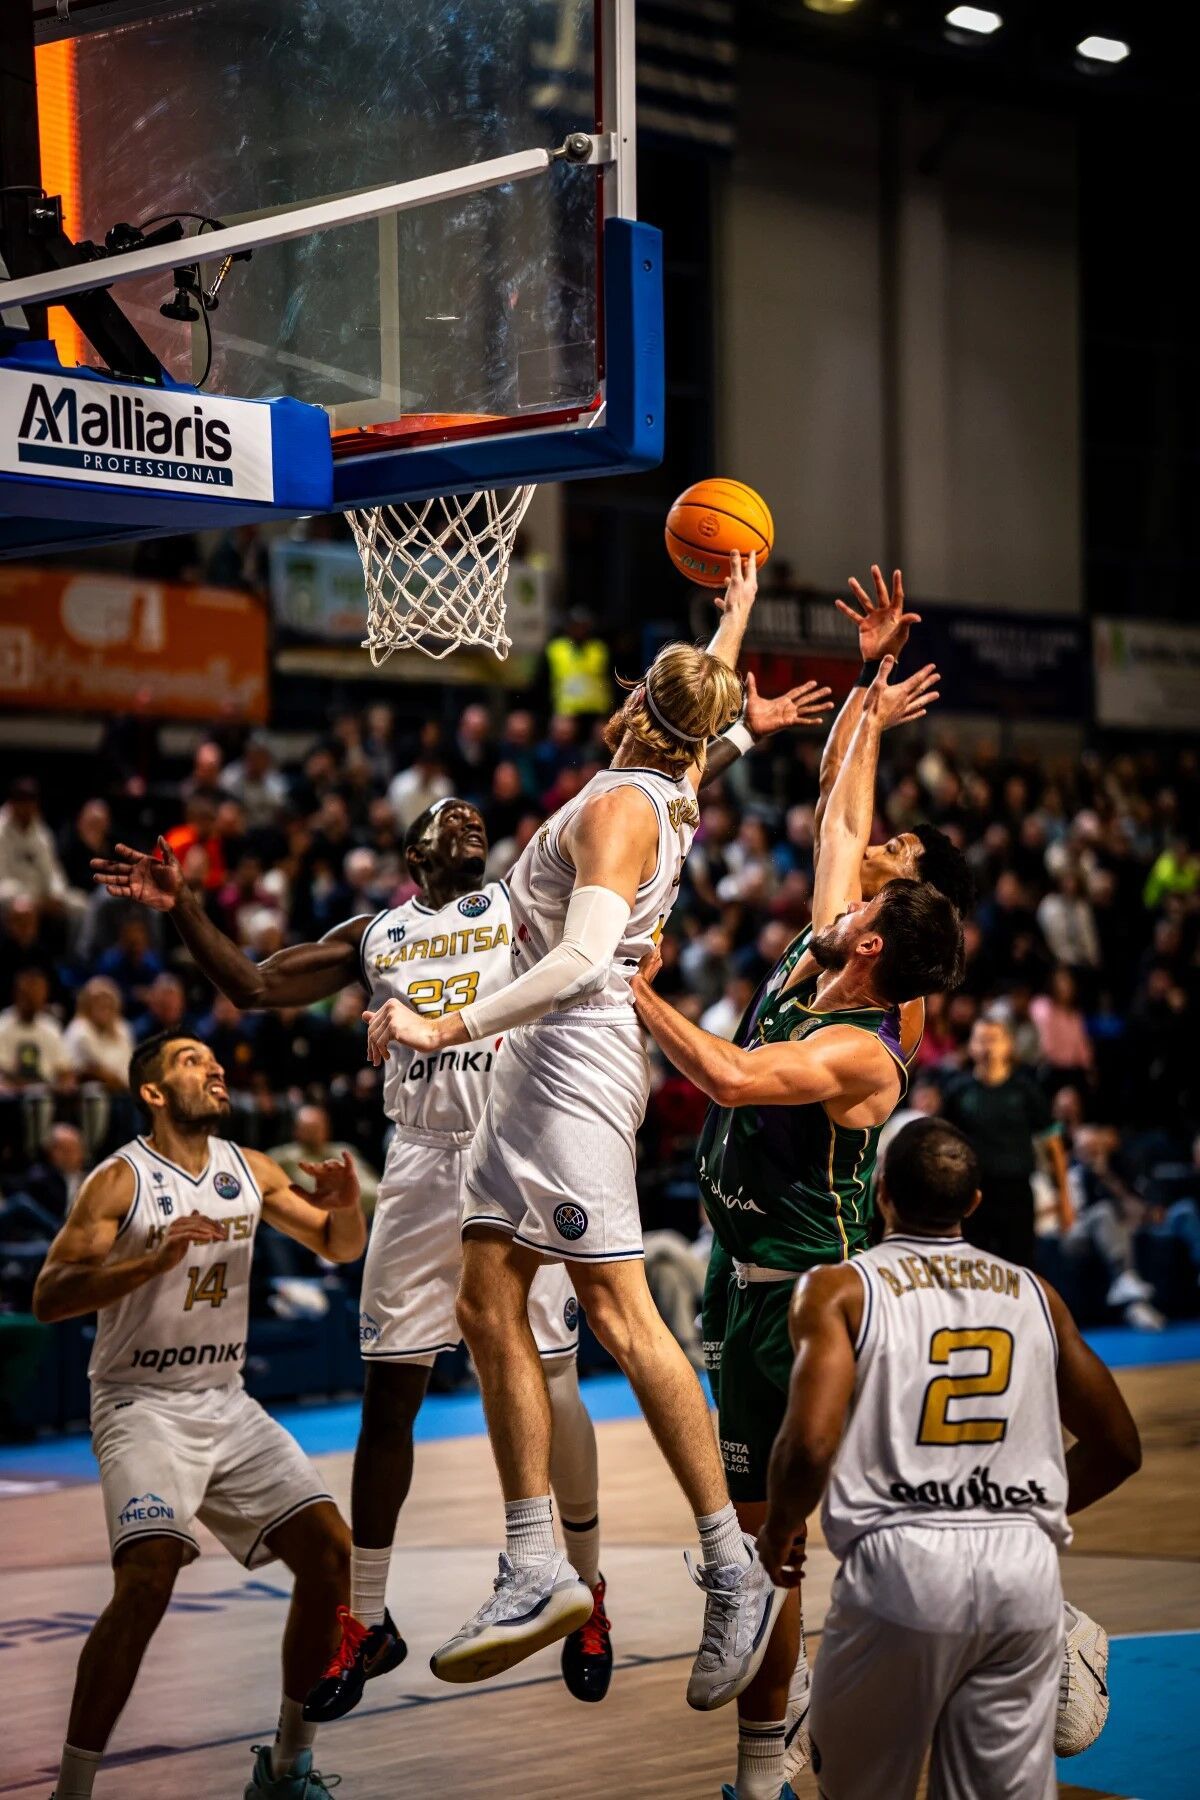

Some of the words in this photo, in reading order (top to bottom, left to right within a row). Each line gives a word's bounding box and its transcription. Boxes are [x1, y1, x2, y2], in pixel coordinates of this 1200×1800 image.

[18, 383, 232, 462] Malliaris
[83, 453, 227, 484] PROFESSIONAL
[374, 923, 510, 972] KARDITSA
[407, 971, 480, 1020] 23
[184, 1262, 227, 1311] 14
[916, 1326, 1014, 1446] 2
[720, 1440, 749, 1454] COSTA
[731, 1454, 750, 1464] SOL
[726, 1463, 750, 1474] LAGA
[118, 1506, 174, 1526] THEONI
